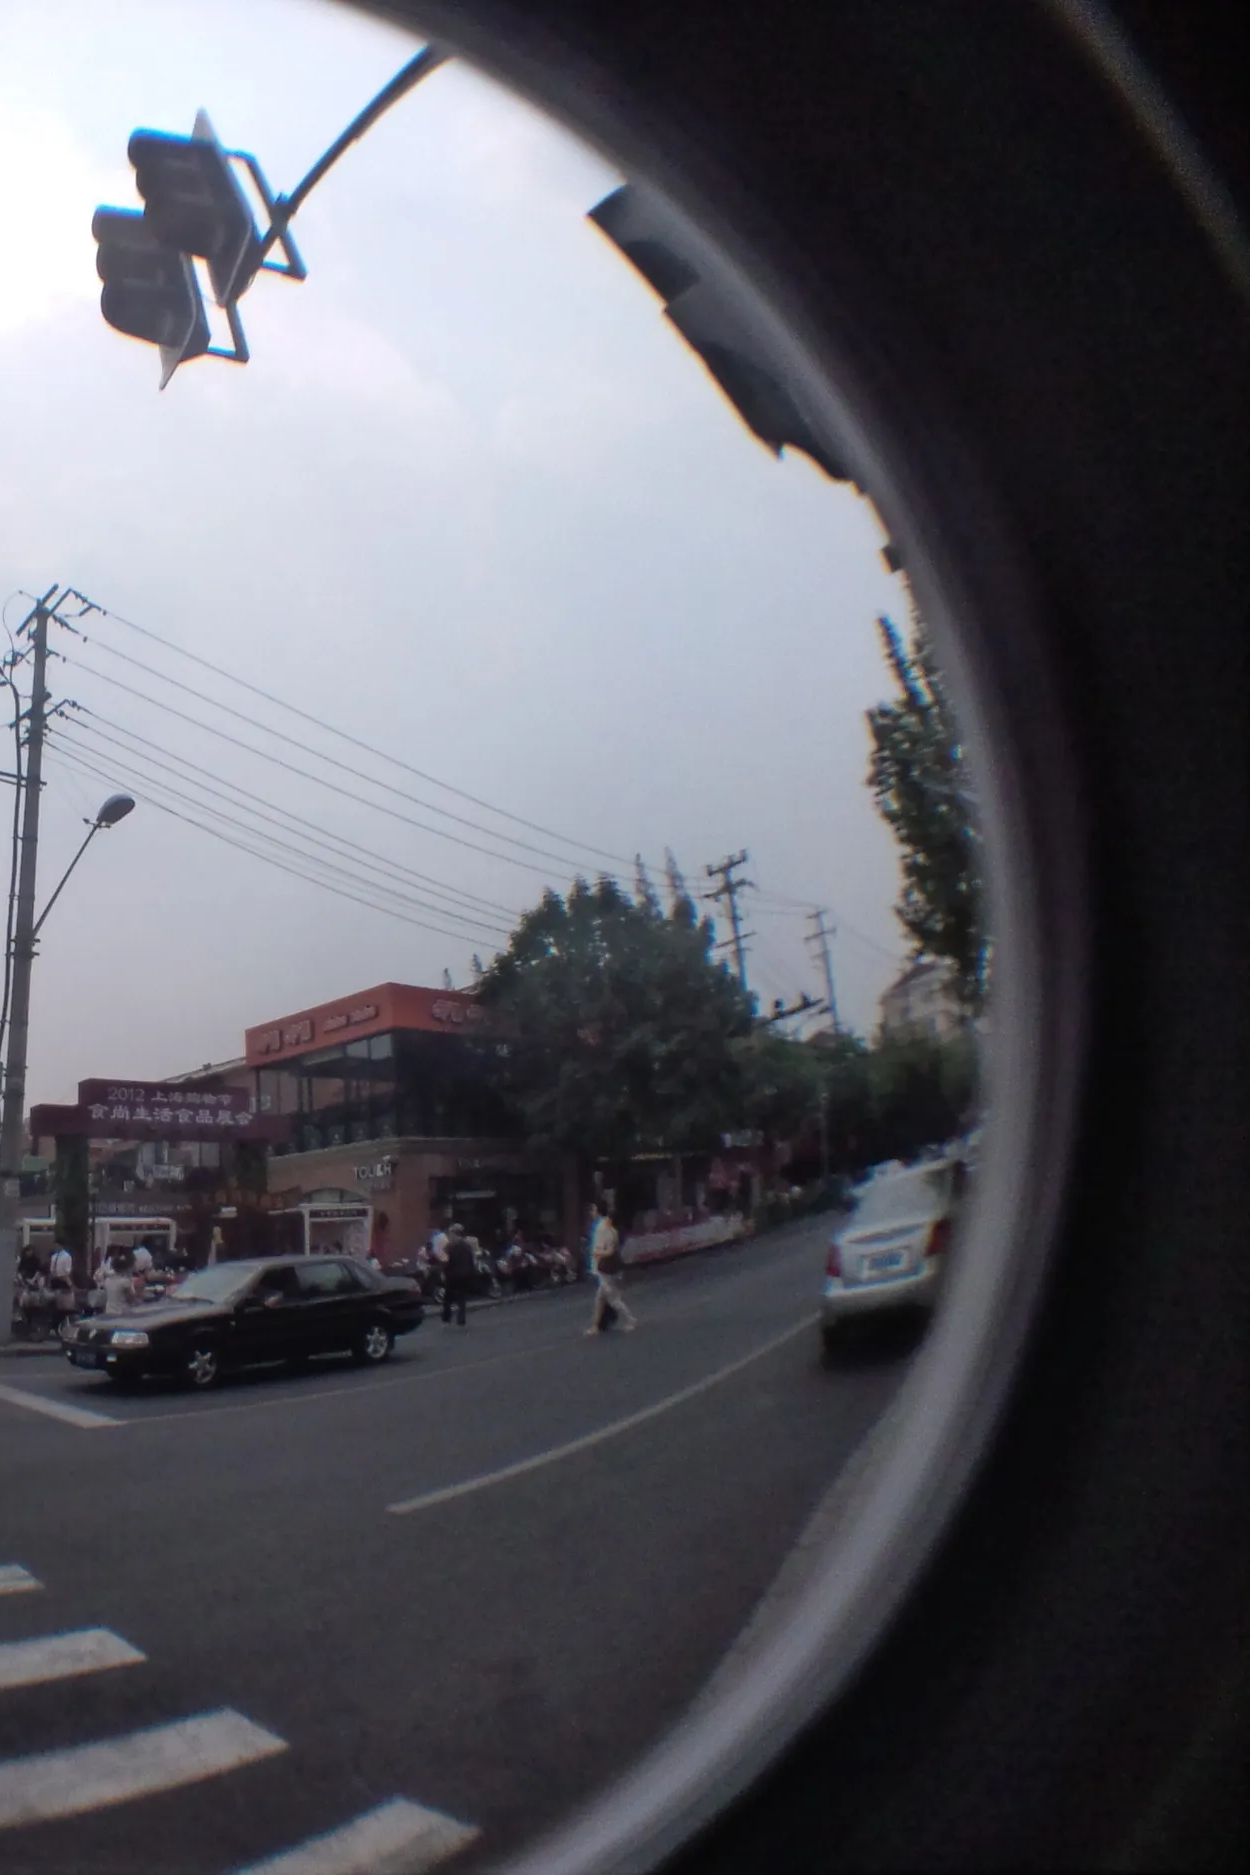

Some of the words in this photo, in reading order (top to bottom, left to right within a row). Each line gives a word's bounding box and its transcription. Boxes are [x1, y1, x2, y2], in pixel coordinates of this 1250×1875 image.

[108, 1086, 145, 1102] 2012
[88, 1103, 253, 1125] 食尚生活食品展会
